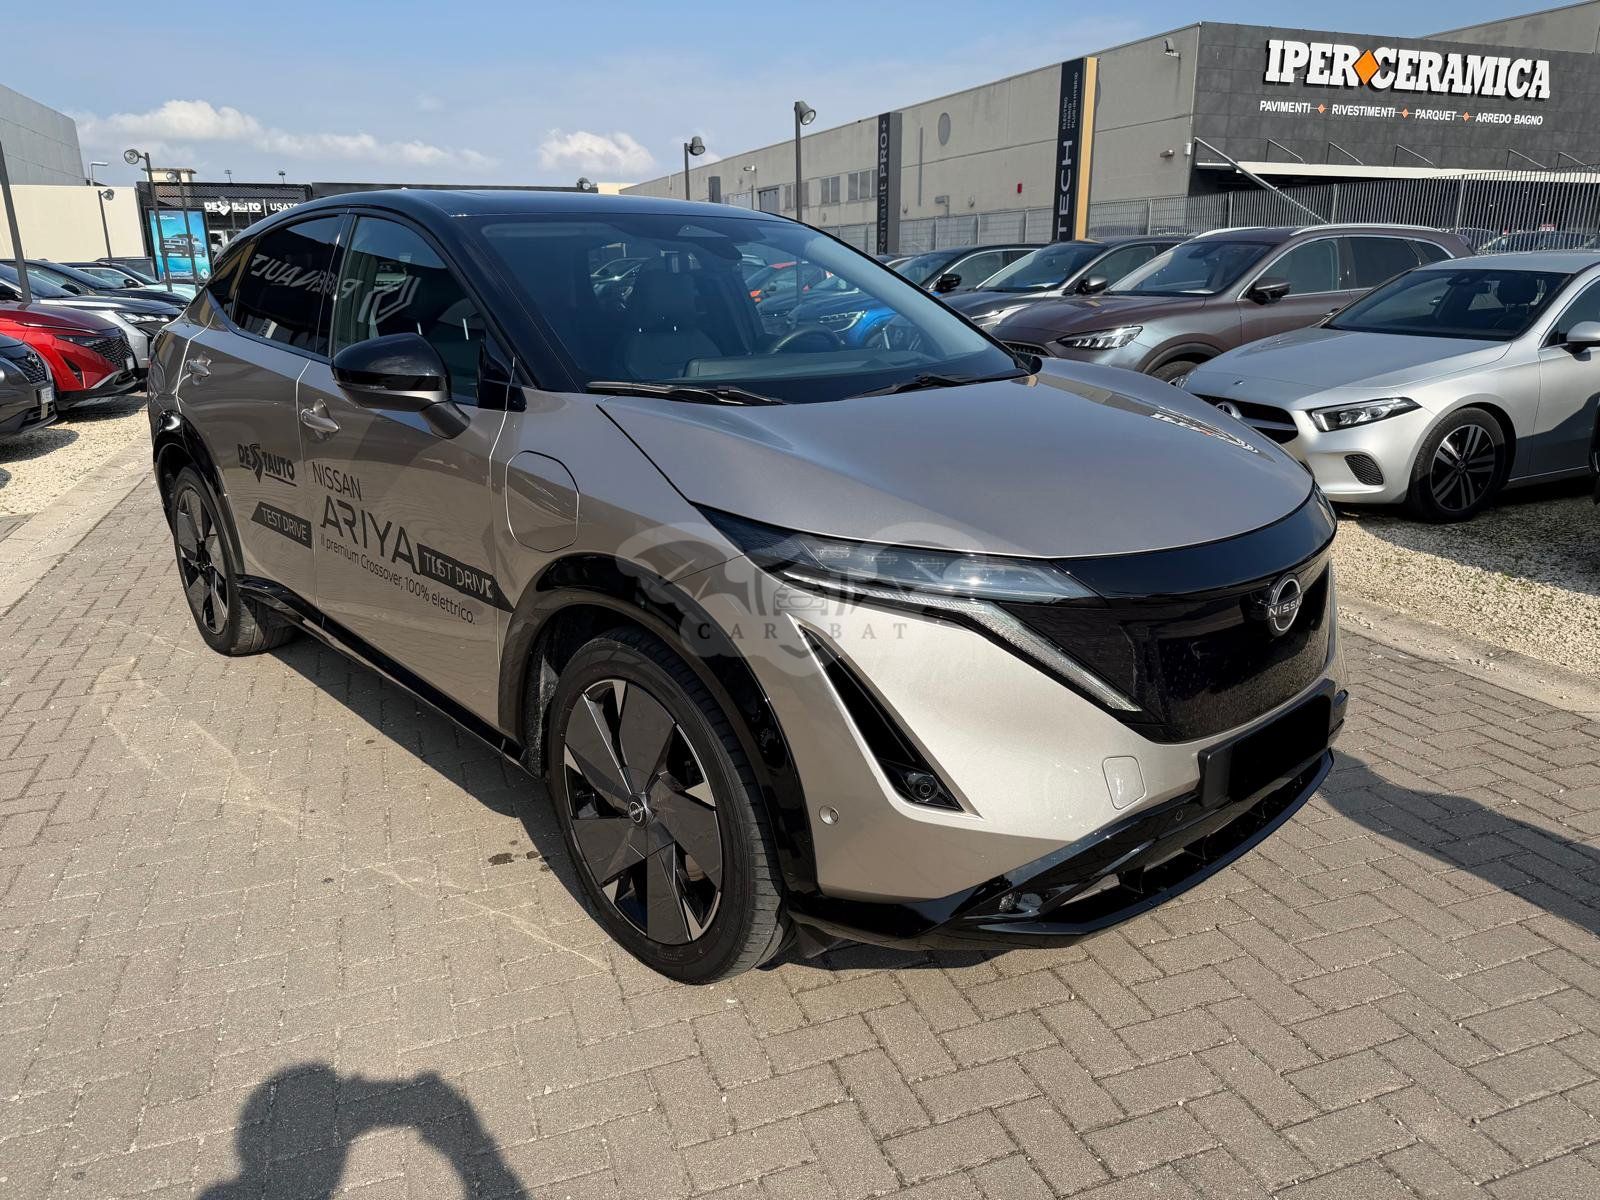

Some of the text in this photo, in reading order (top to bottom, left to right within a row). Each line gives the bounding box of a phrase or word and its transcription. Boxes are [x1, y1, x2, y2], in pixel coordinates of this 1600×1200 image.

[1259, 100, 1544, 126] PAVIMENTI RIVESTIMENTI PARQUET ARREDO BAGNO
[878, 120, 888, 255] Renault PRO+
[312, 461, 362, 501] NISSAN
[261, 506, 308, 541] TEST DRIVE
[320, 495, 421, 576] ARIYA
[326, 538, 360, 566] premium
[361, 554, 404, 591] Crossover,
[404, 576, 430, 602] 100%
[432, 591, 476, 625] elettrico.
[423, 552, 493, 599] TEST DRIVE
[1267, 593, 1303, 617] NISSA
